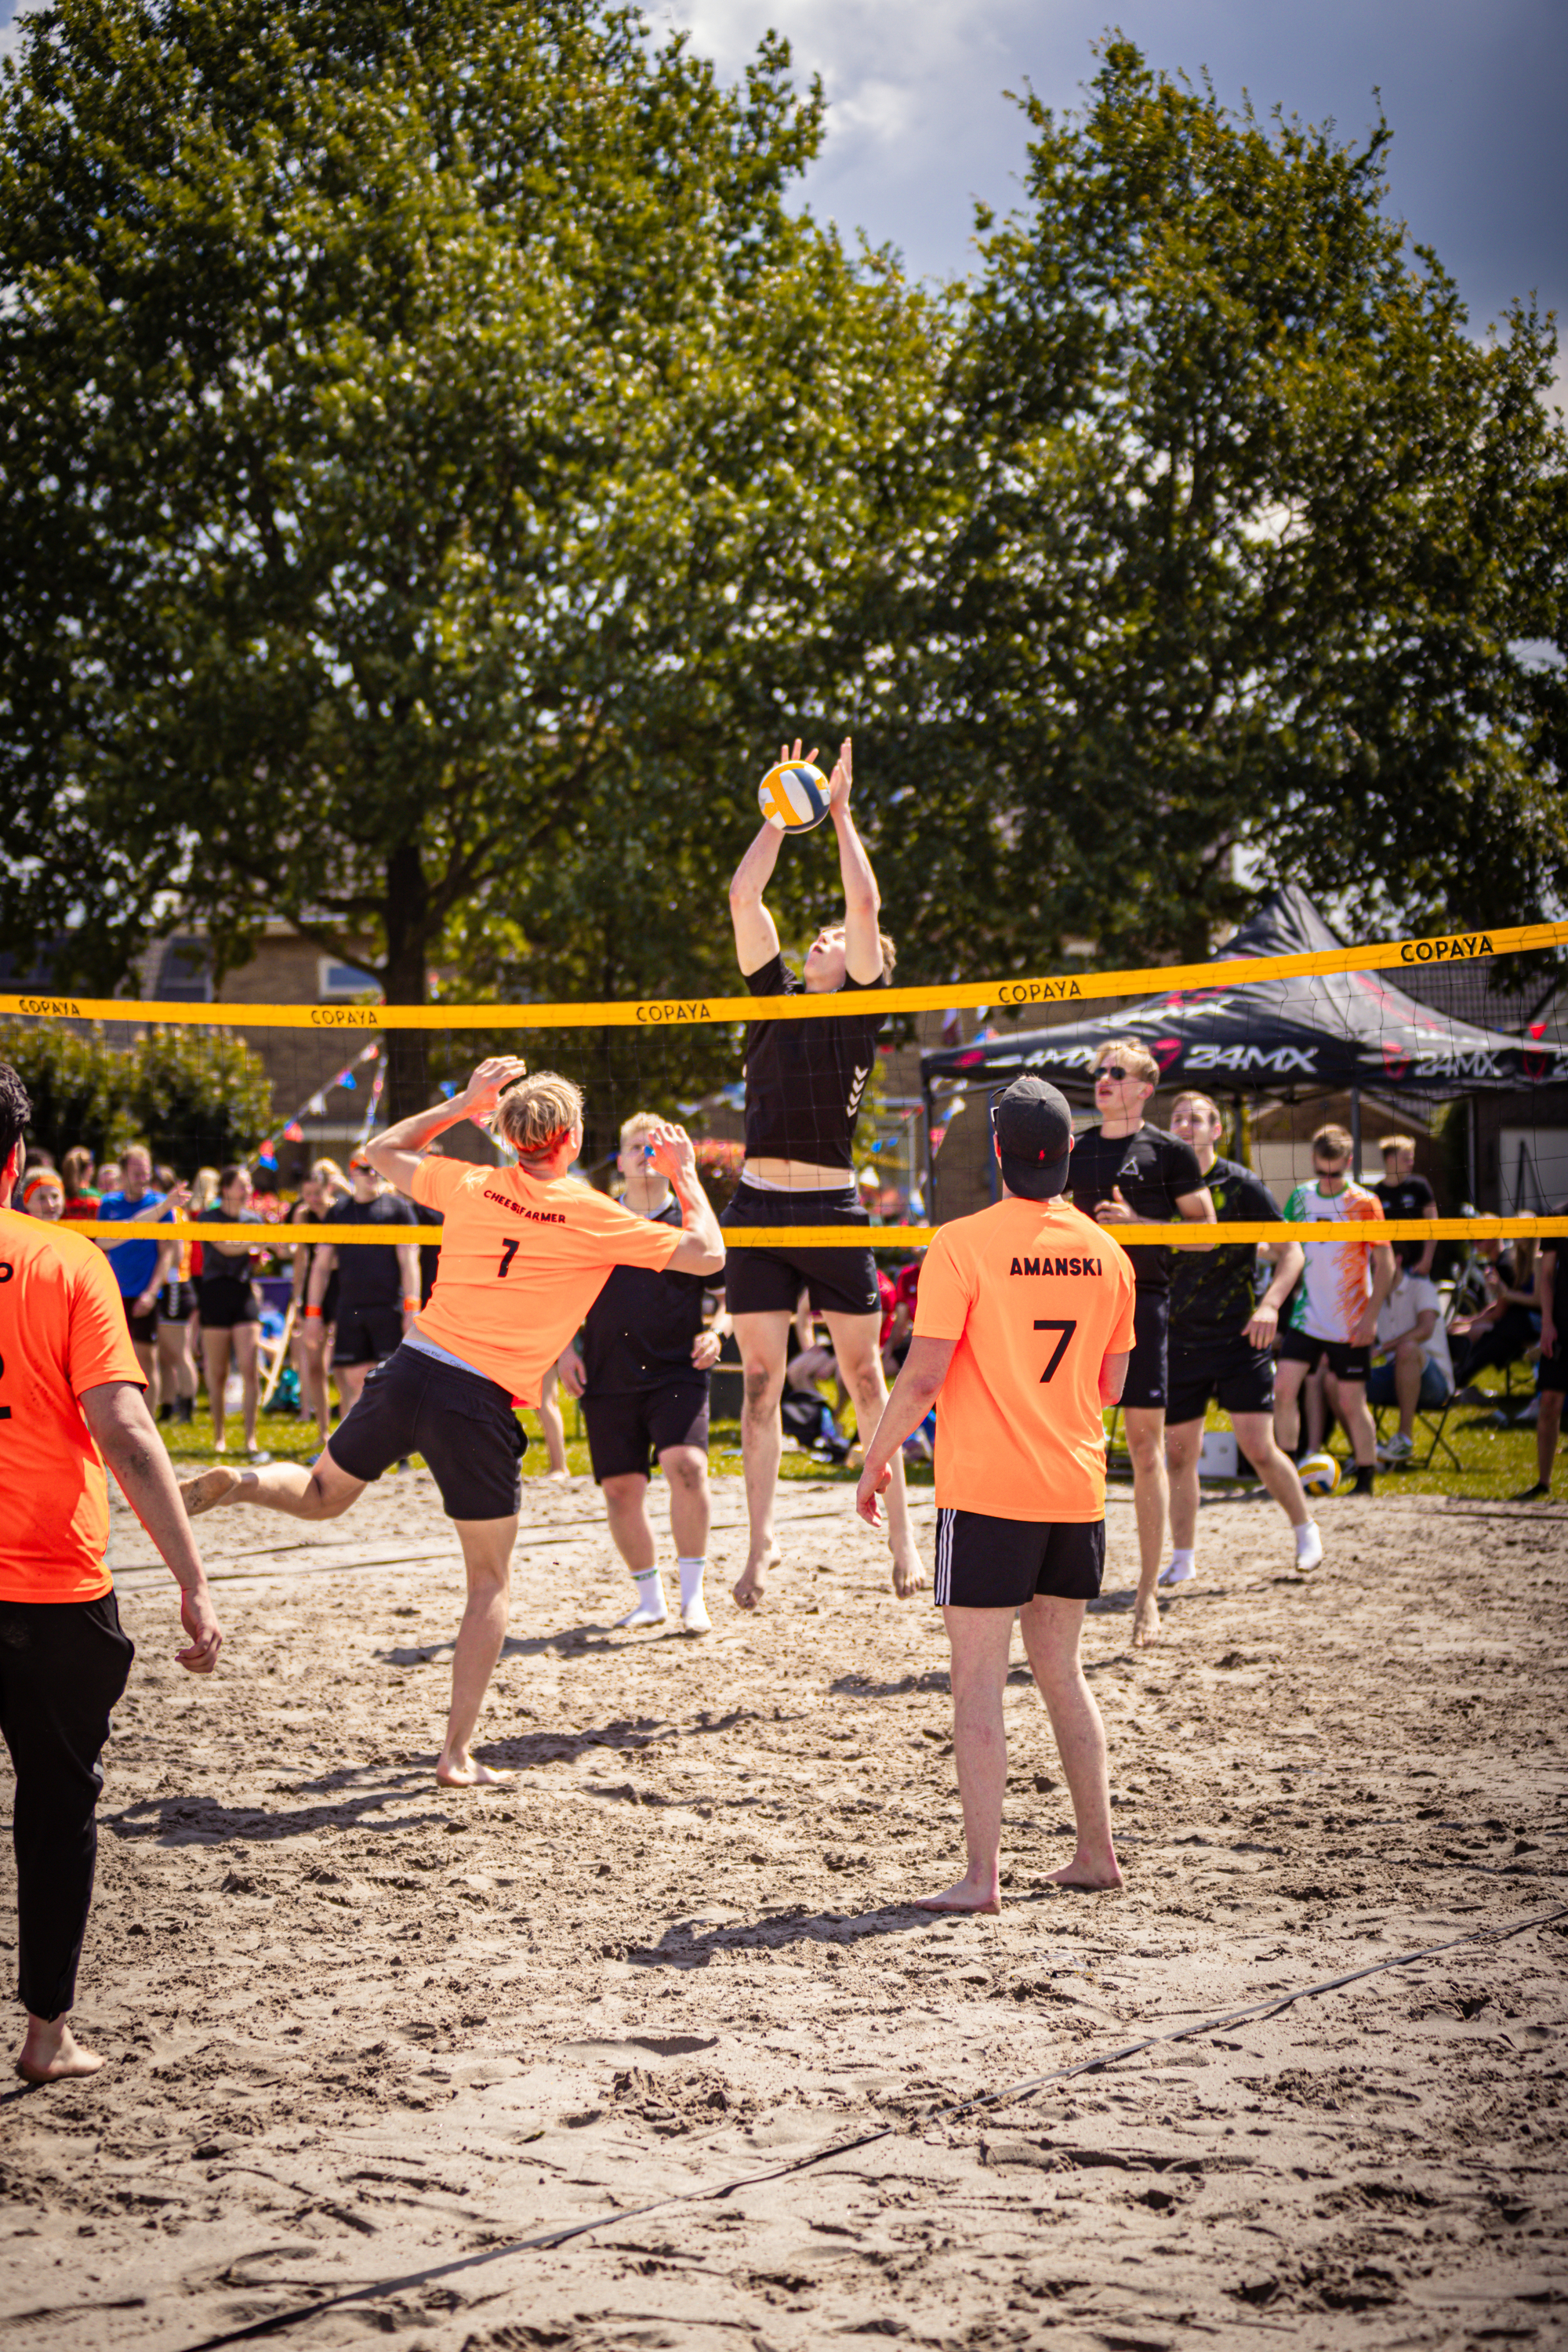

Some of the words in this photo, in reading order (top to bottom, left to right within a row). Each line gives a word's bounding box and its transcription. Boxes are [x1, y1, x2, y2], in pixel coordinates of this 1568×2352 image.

[1400, 935, 1494, 963] COPAYA
[998, 980, 1082, 1004] COPAYA
[19, 999, 81, 1016] COPAYA
[310, 1010, 378, 1025] COPAYA
[636, 1003, 711, 1022] COPAYA
[1182, 1044, 1319, 1074] 24MX
[1414, 1050, 1504, 1078] 24MX
[497, 1238, 520, 1278] 7
[1010, 1258, 1102, 1276] AMANSKI
[1033, 1319, 1077, 1384] 7
